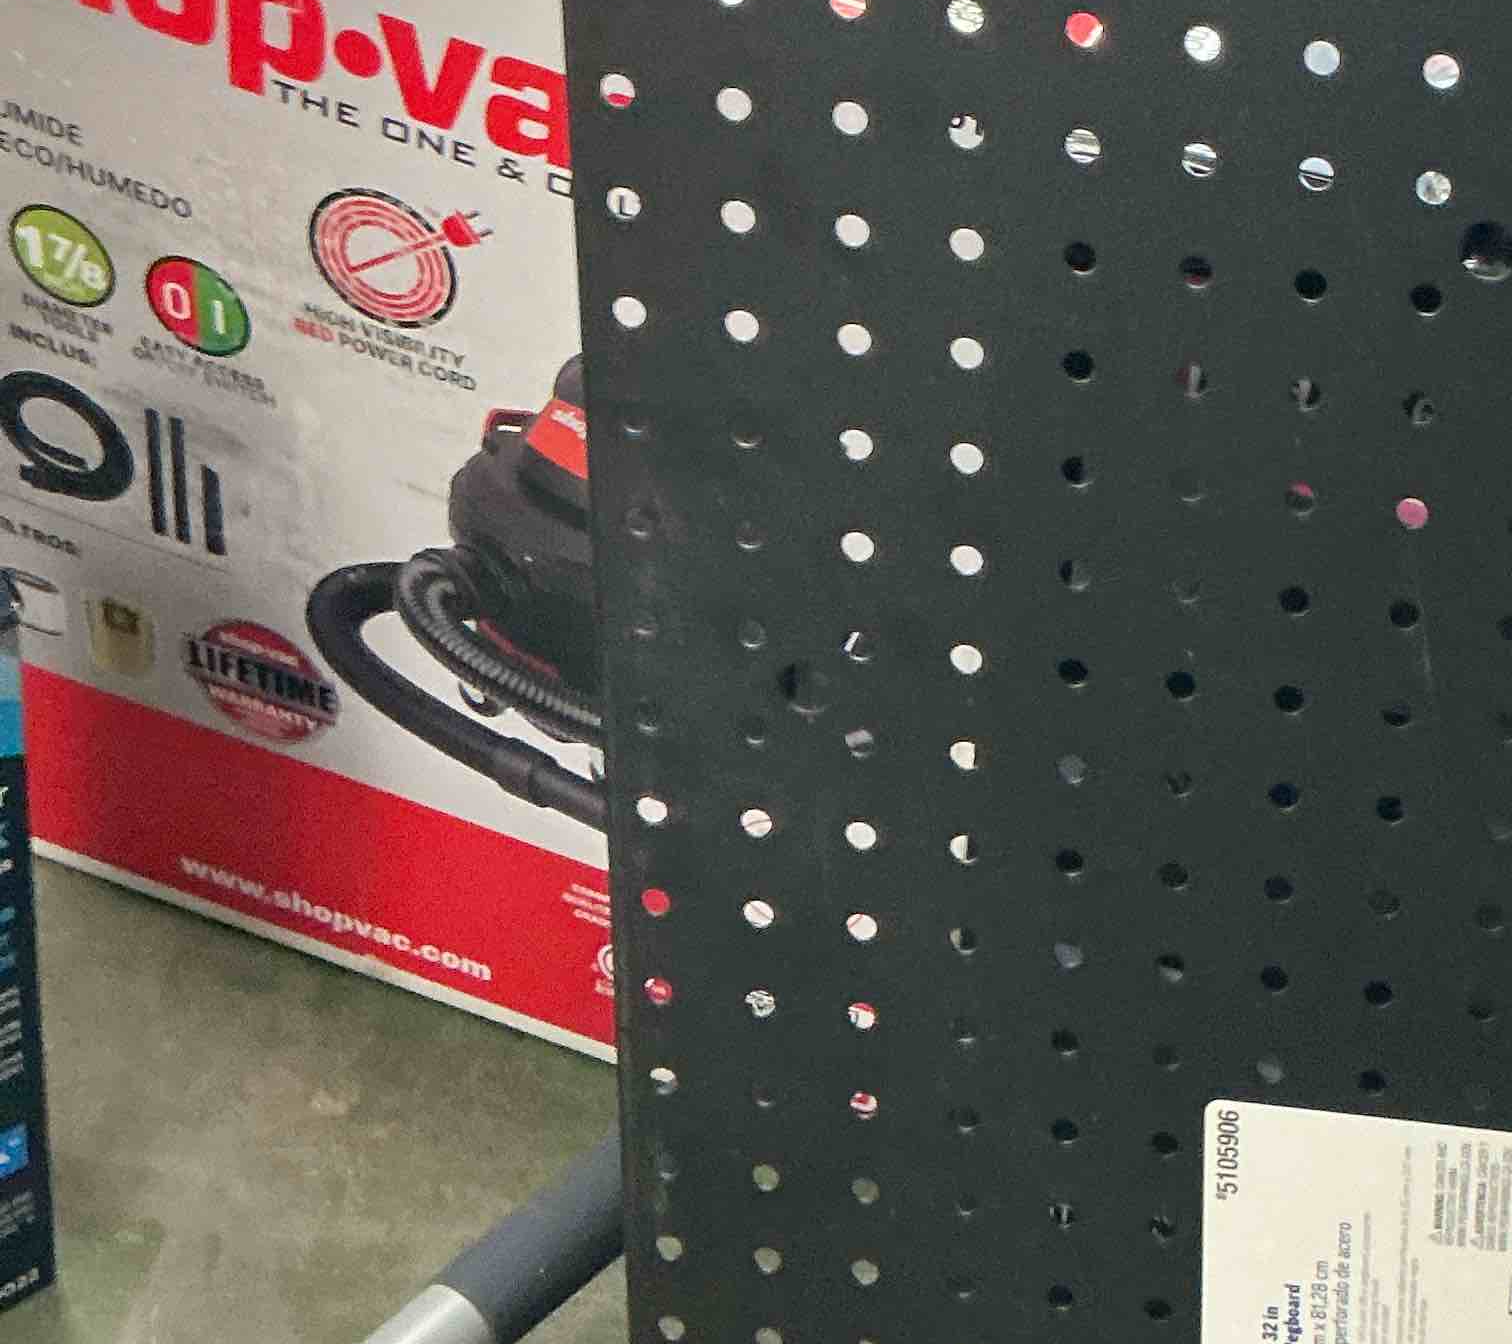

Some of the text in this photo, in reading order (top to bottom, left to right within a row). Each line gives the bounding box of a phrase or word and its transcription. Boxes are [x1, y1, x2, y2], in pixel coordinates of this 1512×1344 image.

[273, 80, 525, 182] THE ONE &
[338, 331, 413, 371] POWER
[418, 360, 478, 391] CORD
[188, 638, 339, 715] LIFETIME
[180, 856, 492, 983] www.shopvac.com
[1215, 1109, 1240, 1201] #5105906
[1337, 1222, 1353, 1260] acero
[1316, 1260, 1330, 1281] cm
[1332, 1262, 1350, 1279] de
[1263, 1306, 1279, 1320] in
[1263, 1323, 1279, 1341] 32
[1315, 1322, 1327, 1332] x
